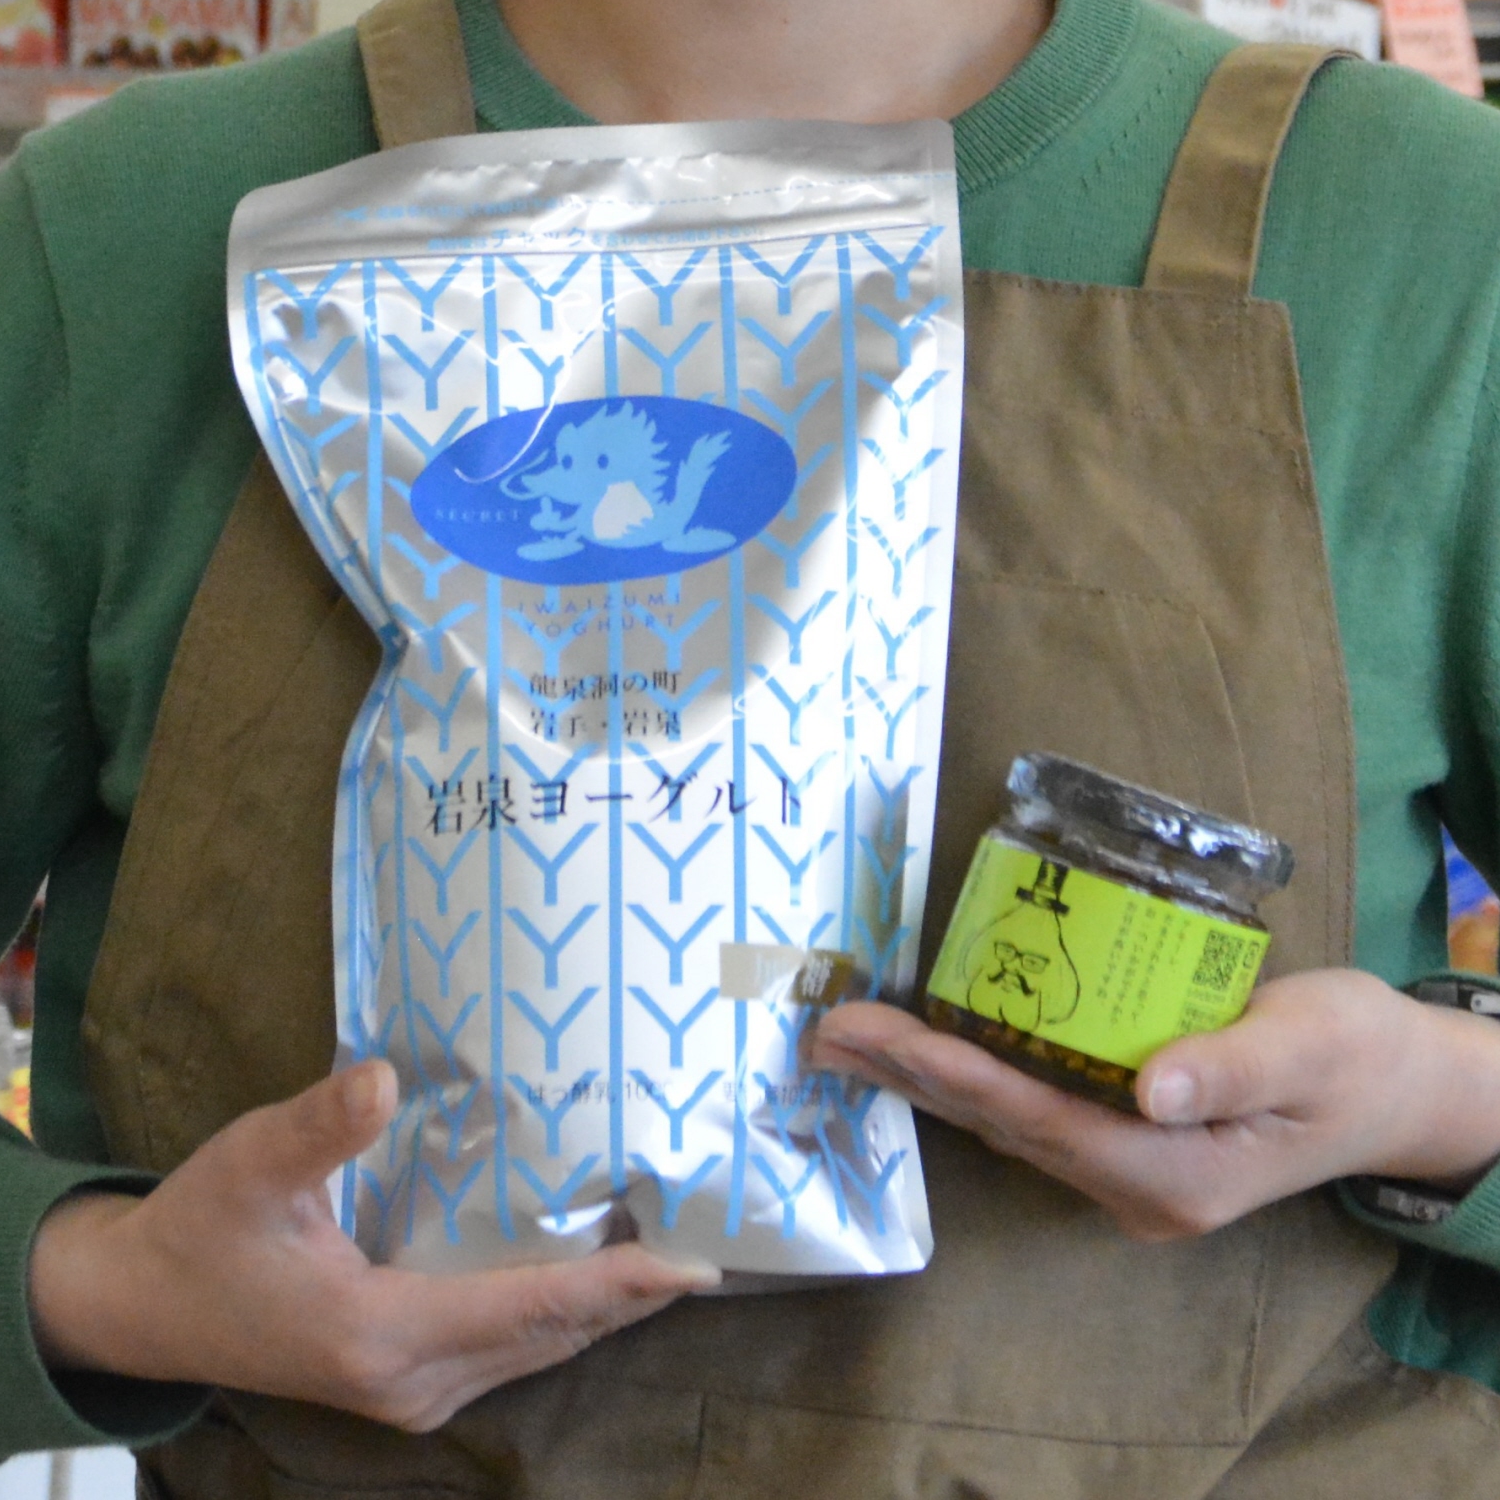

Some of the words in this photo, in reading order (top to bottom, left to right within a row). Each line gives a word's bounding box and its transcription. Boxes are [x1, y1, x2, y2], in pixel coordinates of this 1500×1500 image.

[517, 593, 682, 616] IWAIZUMI
[527, 612, 676, 638] YOGHURT
[529, 669, 684, 700] 龍泉洞の町
[426, 771, 802, 838] 岩泉ヨーグルト
